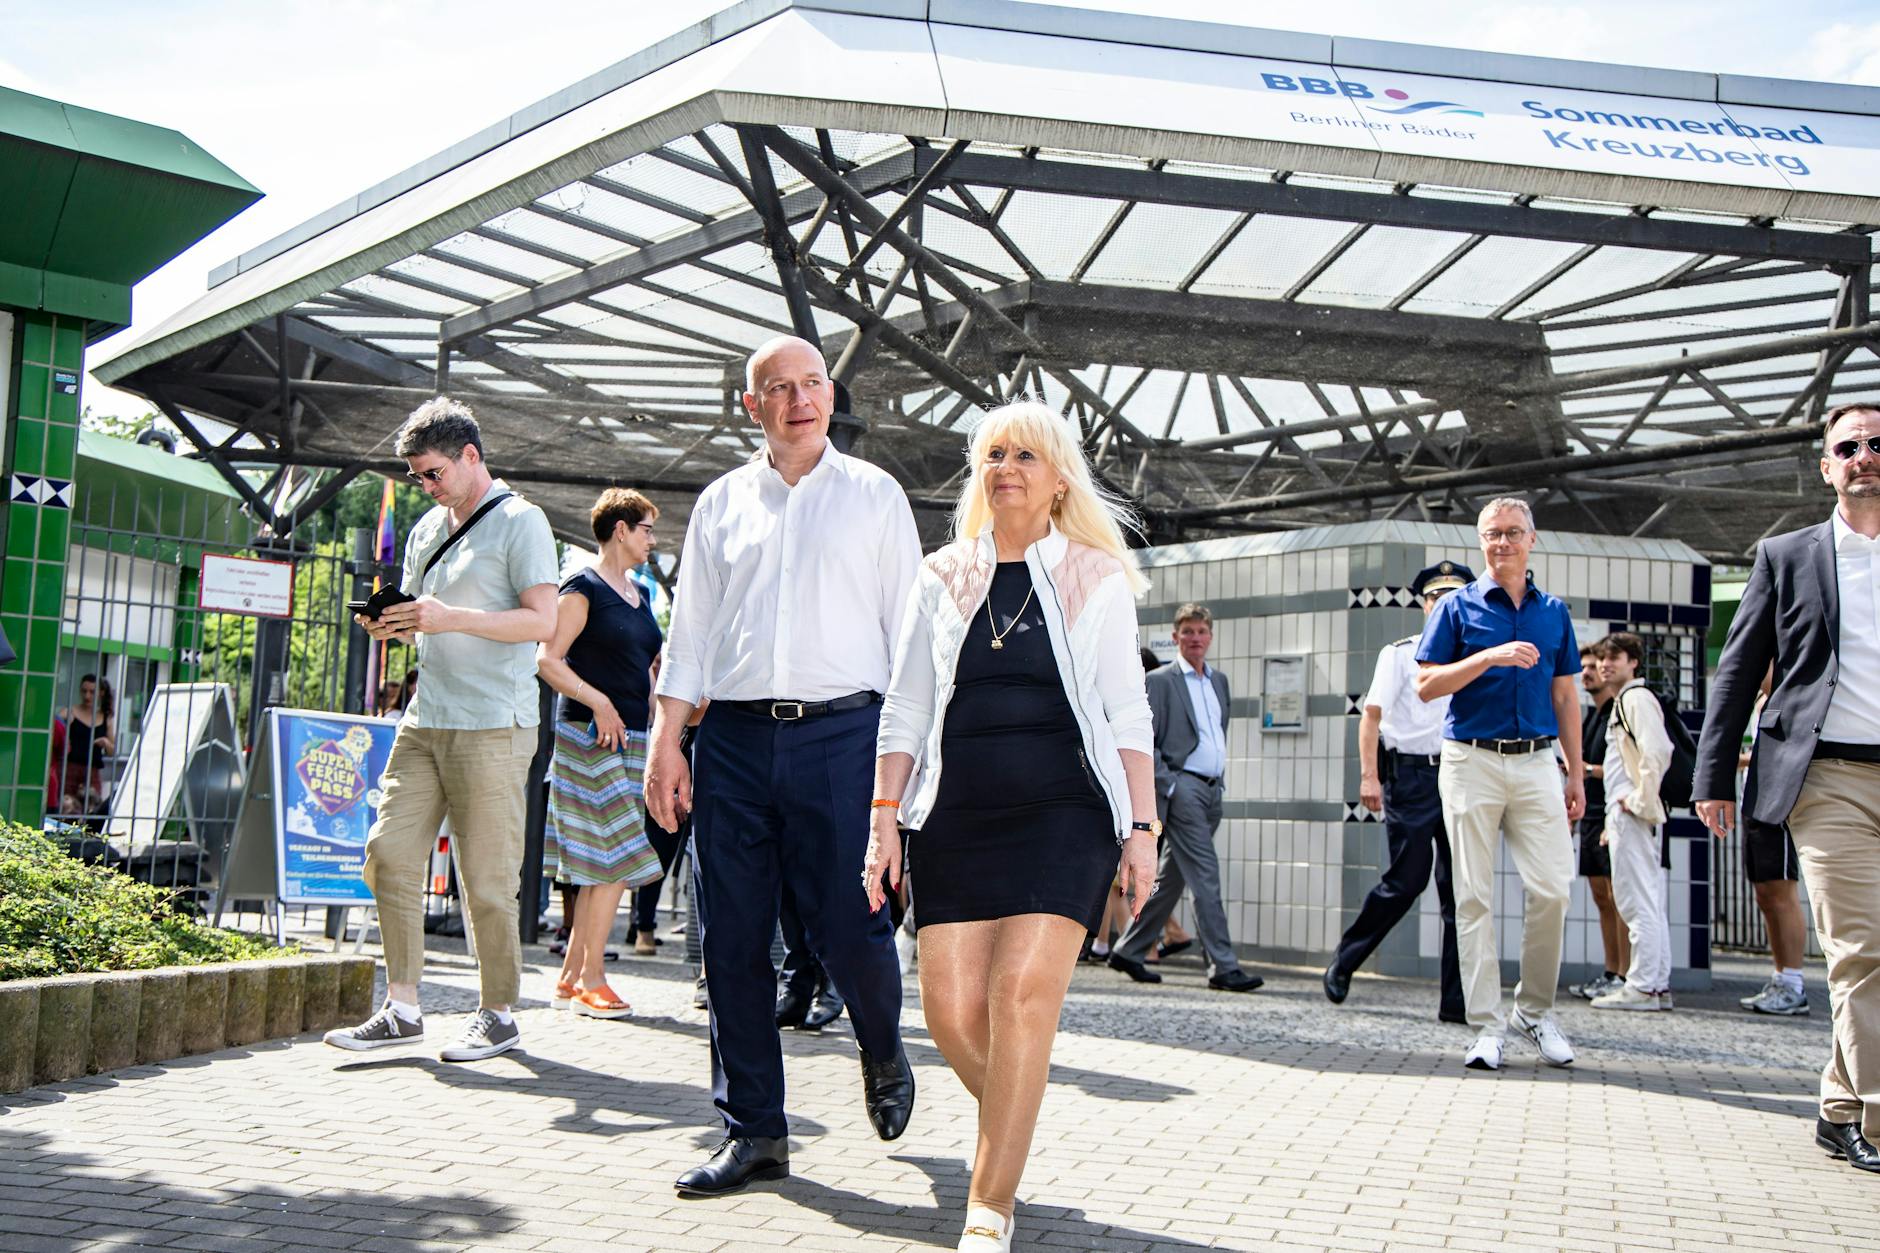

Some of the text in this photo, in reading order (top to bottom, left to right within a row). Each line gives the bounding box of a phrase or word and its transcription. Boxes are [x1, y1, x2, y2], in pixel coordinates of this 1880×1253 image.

[1260, 73, 1374, 99] BBB
[1290, 111, 1478, 140] Berliner Bäder
[1521, 100, 1823, 144] Sommerbad
[1543, 129, 1810, 175] Kreuzberg
[309, 749, 354, 771] SUPER
[310, 778, 353, 799] PASS
